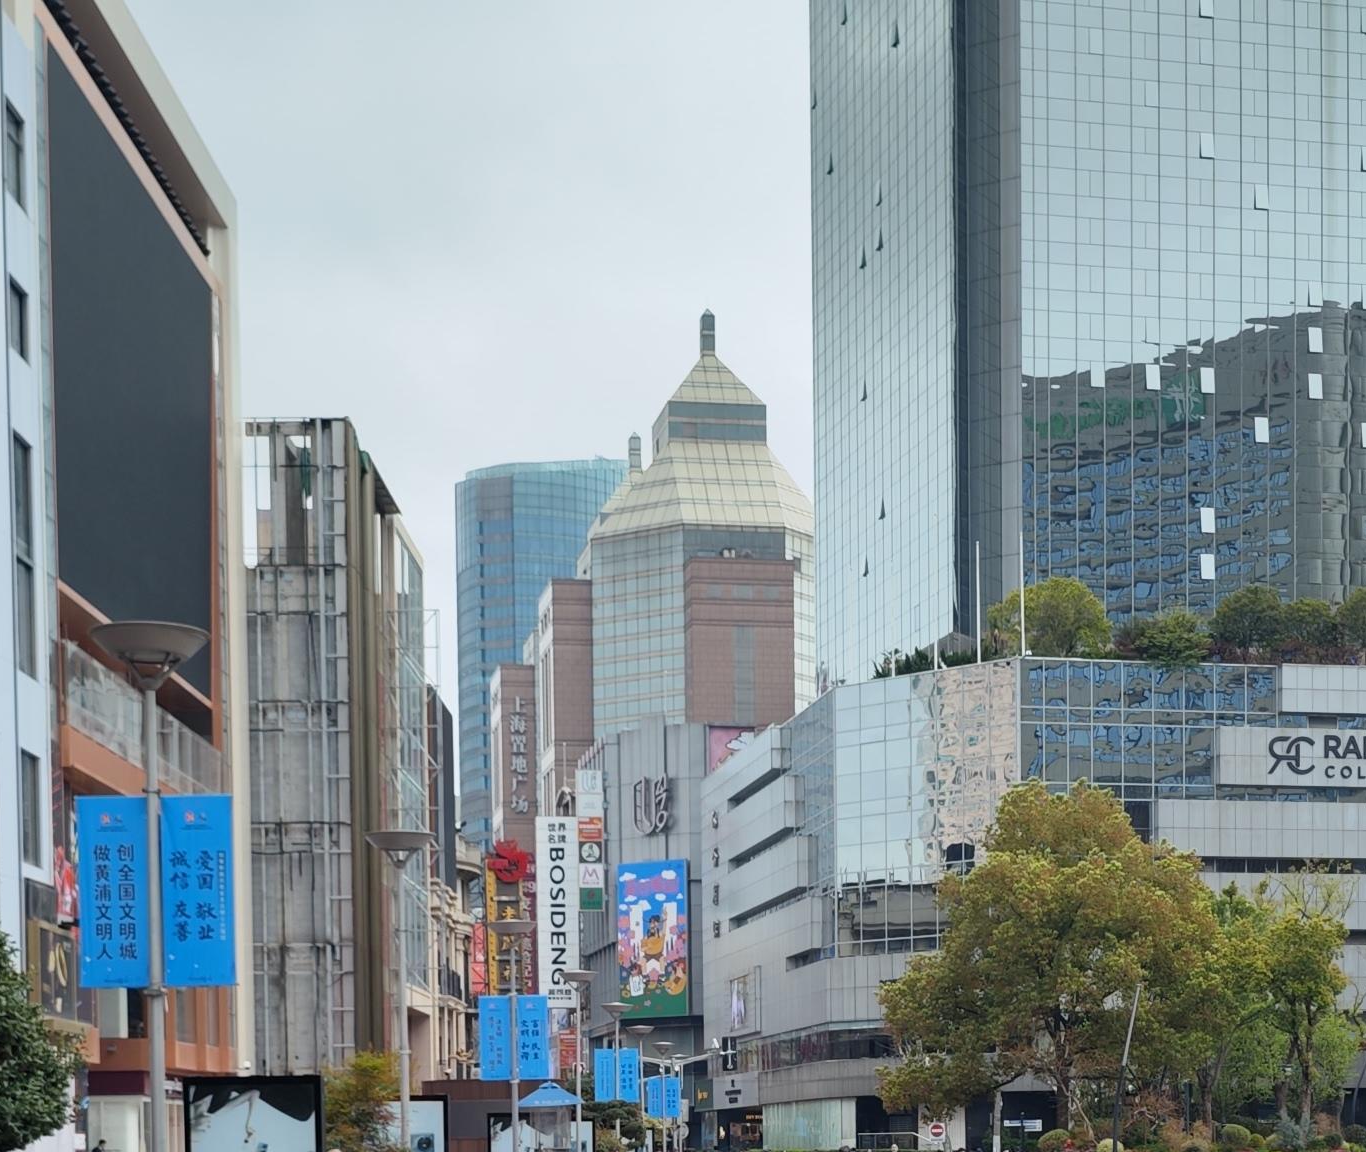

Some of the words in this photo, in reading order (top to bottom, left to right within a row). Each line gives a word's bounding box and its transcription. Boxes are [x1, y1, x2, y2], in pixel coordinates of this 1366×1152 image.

[94, 845, 113, 960] 做黄浦文明人
[117, 845, 137, 960] 创全国文明城
[550, 848, 567, 985] BOSIDENG
